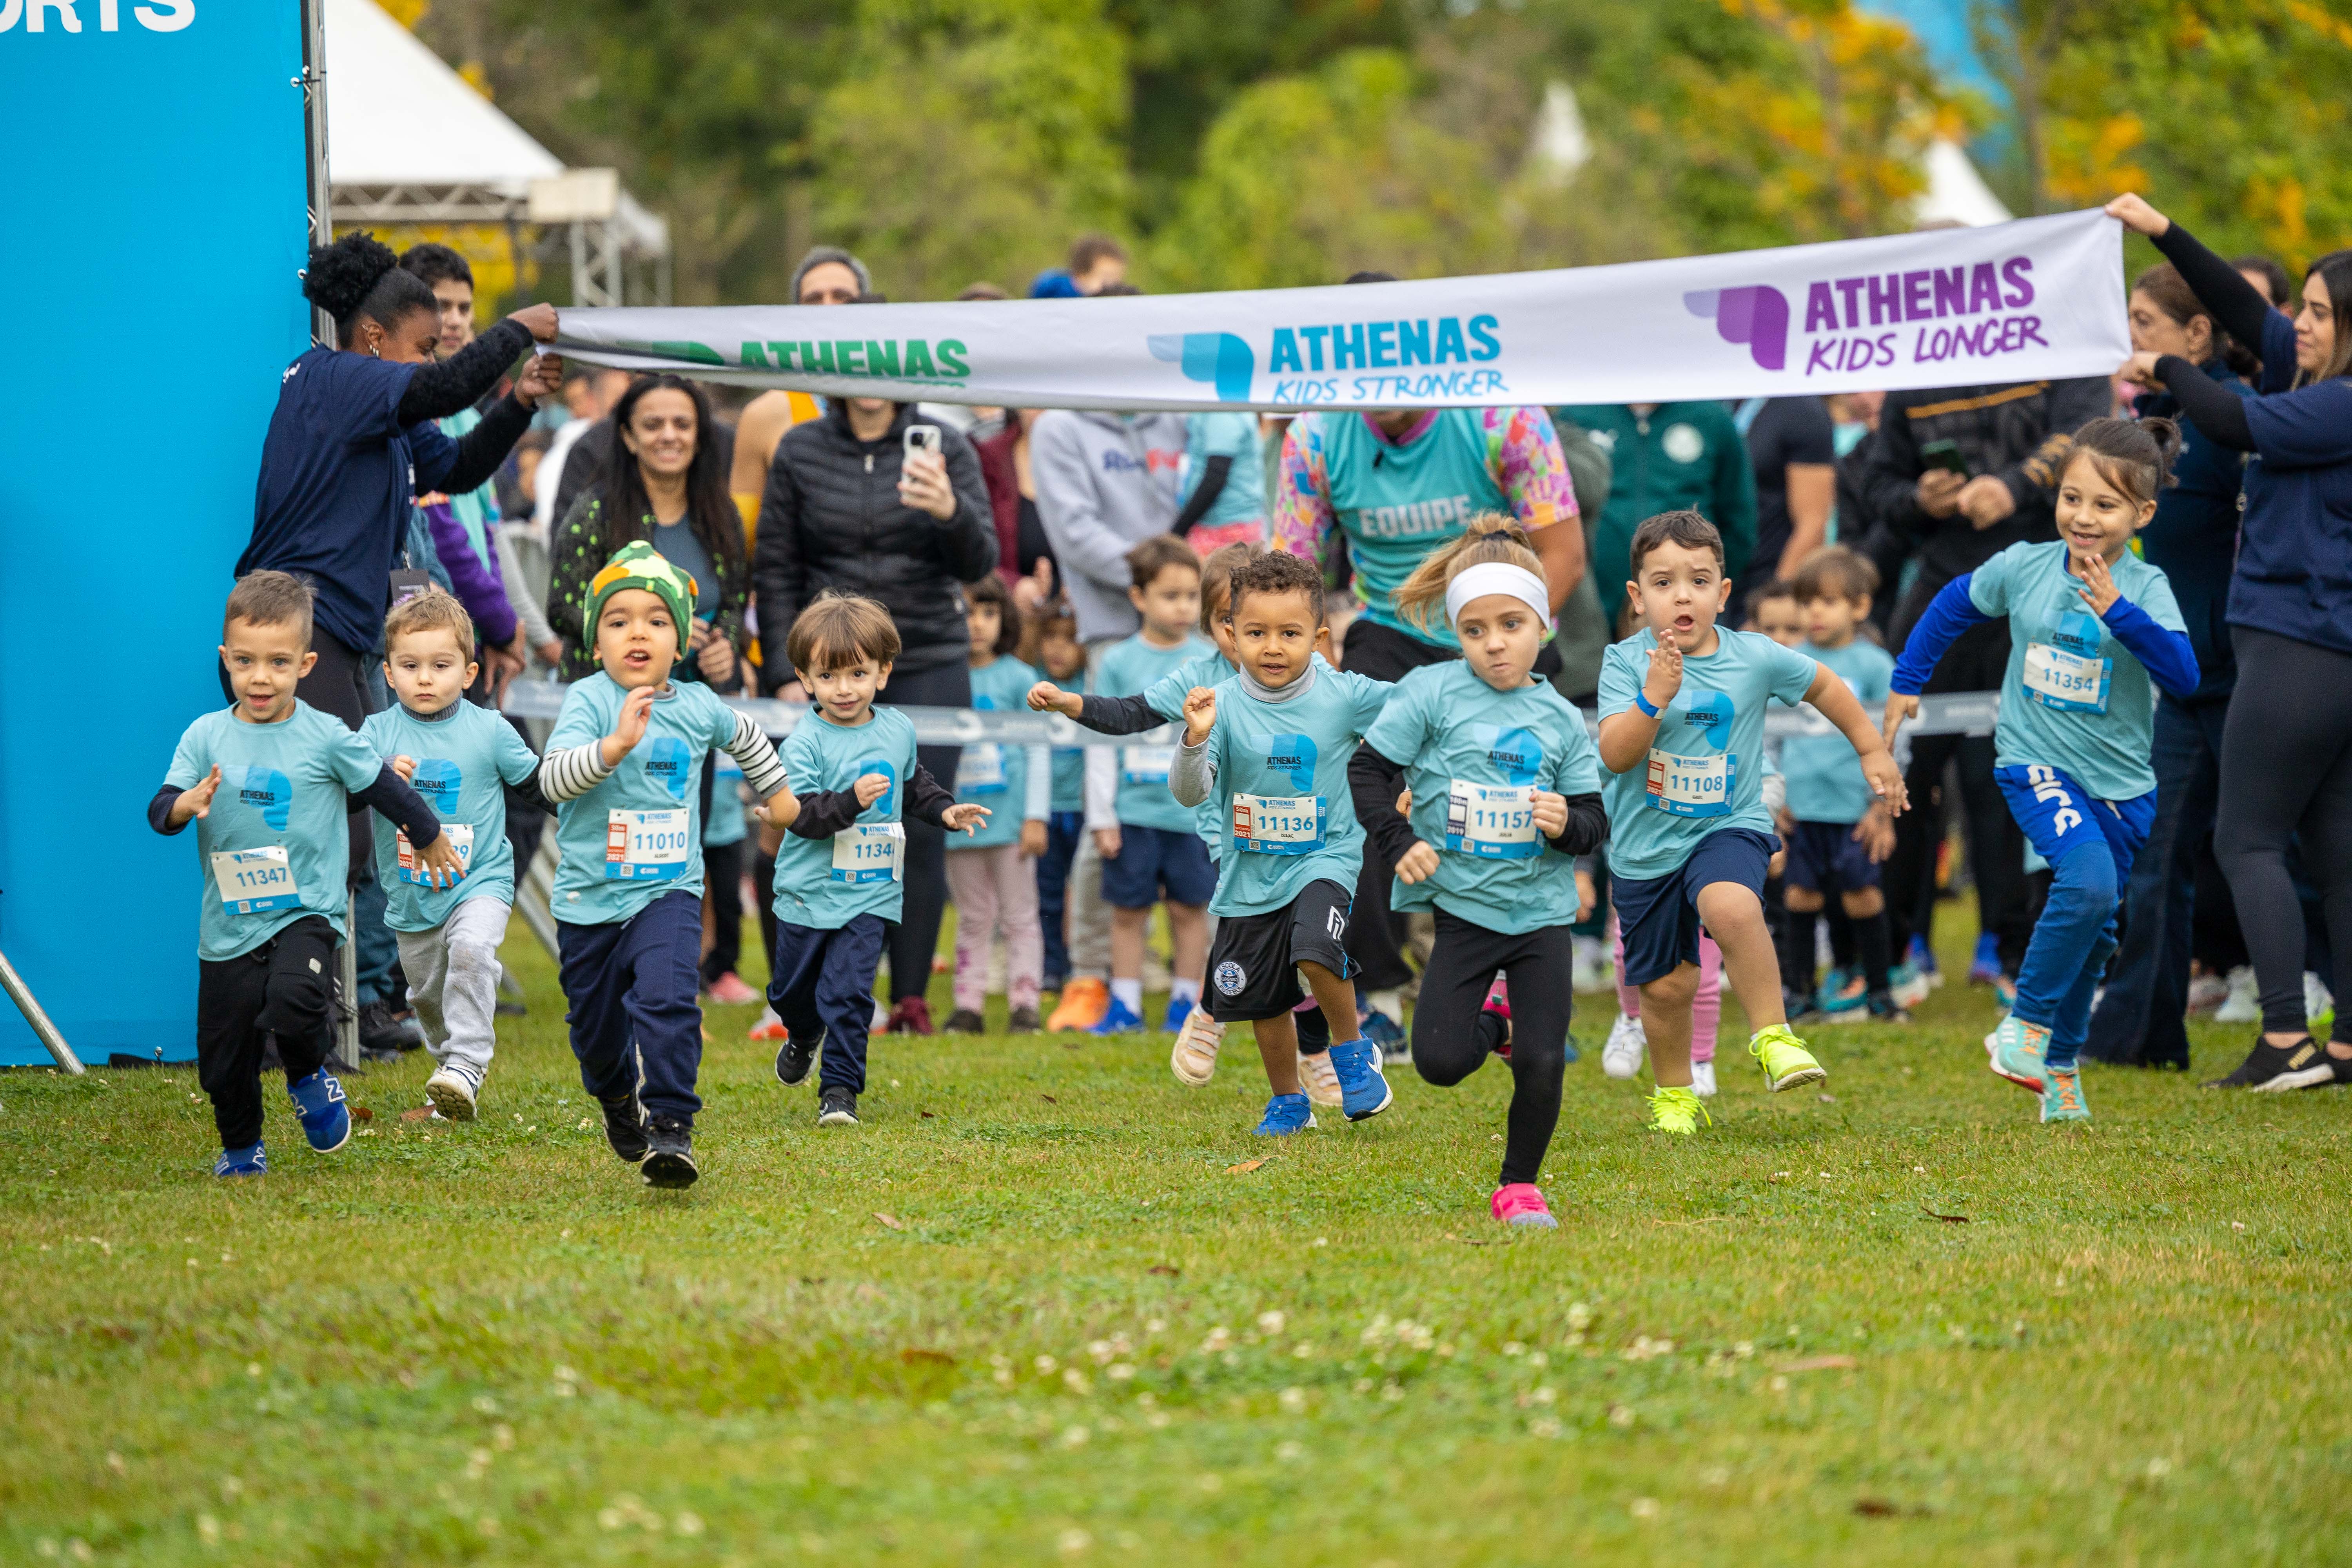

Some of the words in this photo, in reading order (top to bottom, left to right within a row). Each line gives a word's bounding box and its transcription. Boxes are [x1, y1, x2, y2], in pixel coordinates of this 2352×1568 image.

[1804, 256, 2034, 332] ATHENAS
[1269, 314, 1501, 373] ATHENAS
[1806, 333, 1896, 376] KIDS
[1914, 316, 2049, 363] LONGER
[740, 339, 971, 378] ATHENAS
[1271, 378, 1338, 403] KIDS
[1353, 369, 1508, 399] STRONGER
[1359, 494, 1472, 537] EQUIPE
[2044, 668, 2093, 691] 11354
[1685, 713, 1719, 722] ATHENAS
[1267, 756, 1301, 765] ATHENAS
[1488, 750, 1525, 764] ATHENAS
[414, 779, 446, 789] ATHENAS
[1671, 775, 1723, 792] 11108
[240, 790, 274, 800] ATHENAS
[1258, 816, 1314, 831] 11136
[1475, 809, 1533, 828] 11157
[635, 831, 685, 849] 11010
[236, 867, 287, 887] 11347
